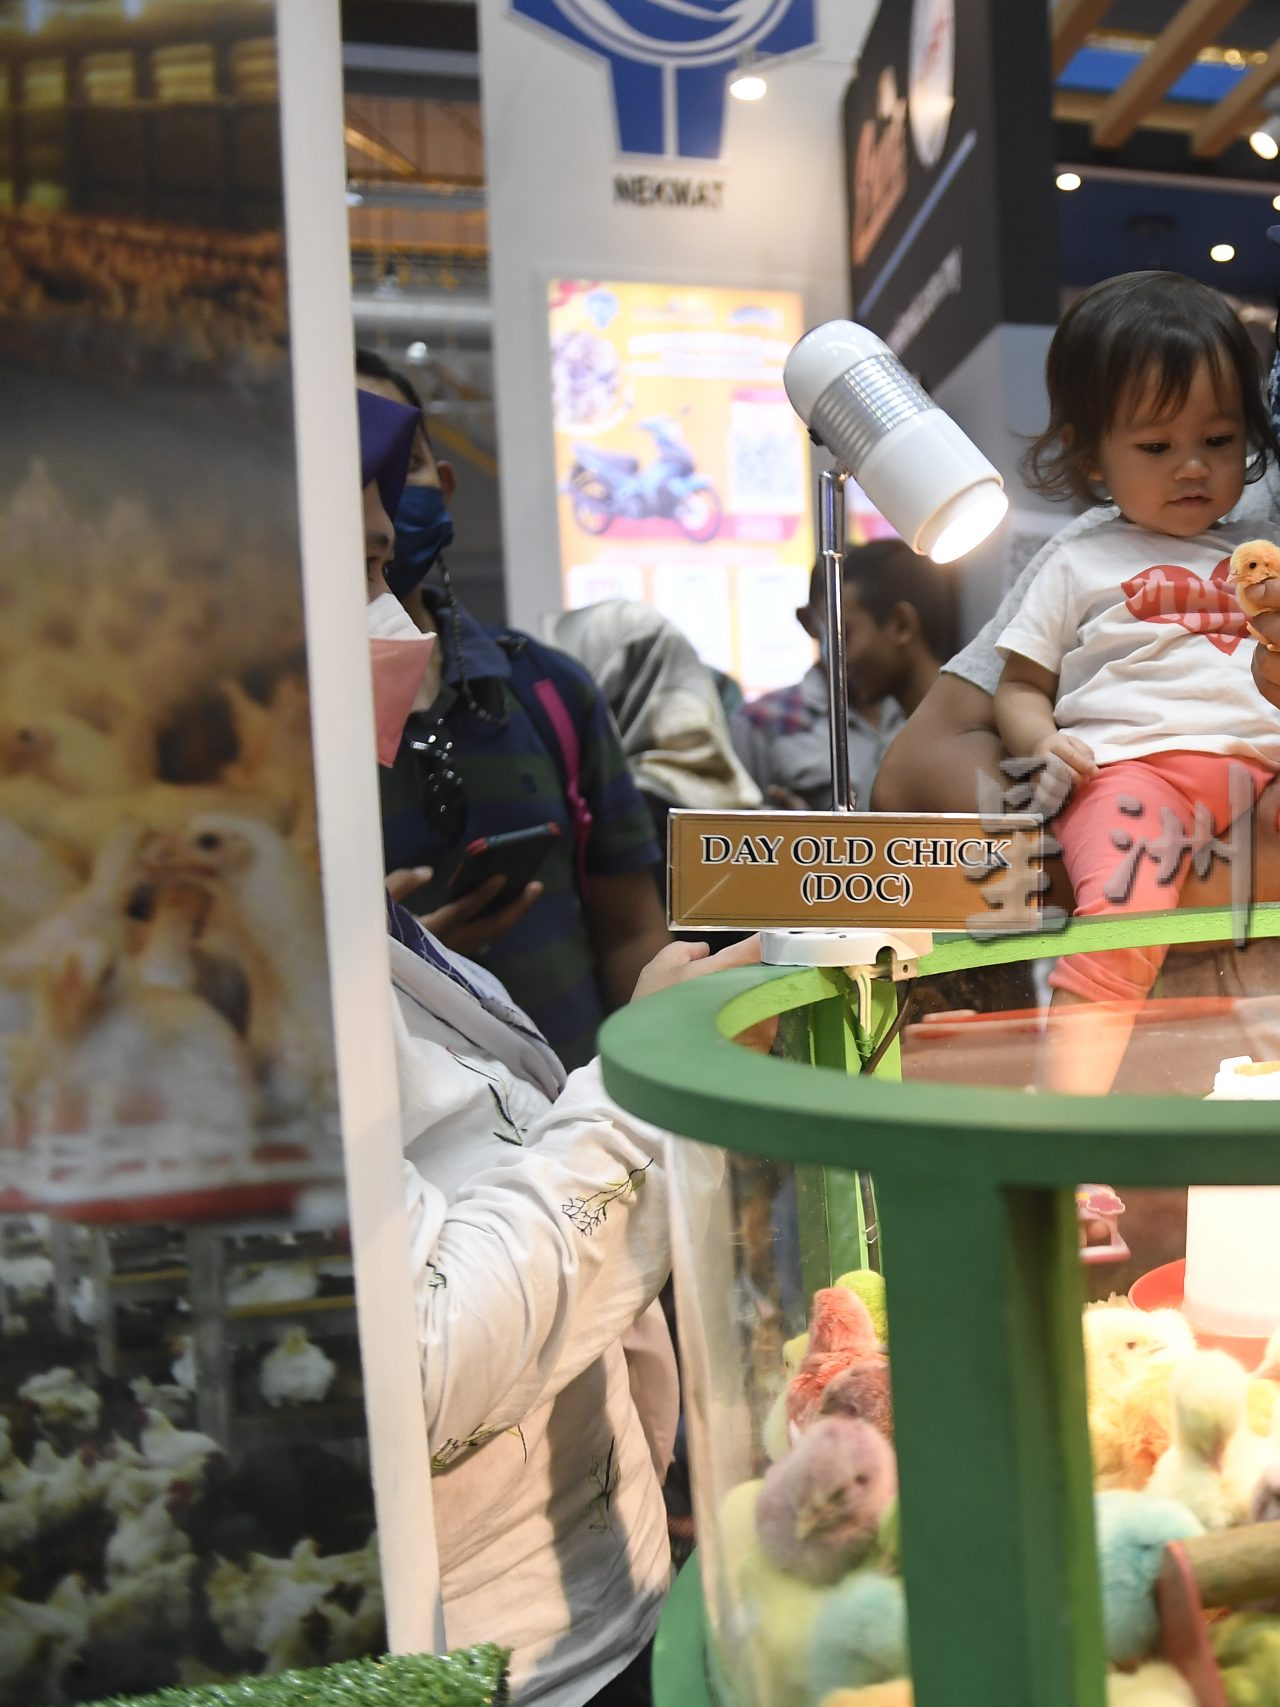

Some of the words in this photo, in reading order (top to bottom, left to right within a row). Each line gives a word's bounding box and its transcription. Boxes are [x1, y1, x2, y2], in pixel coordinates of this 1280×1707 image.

[701, 835, 784, 866] DAY
[790, 836, 876, 867] OLD
[884, 838, 1012, 868] CHICK
[800, 872, 912, 906] (DOC)
